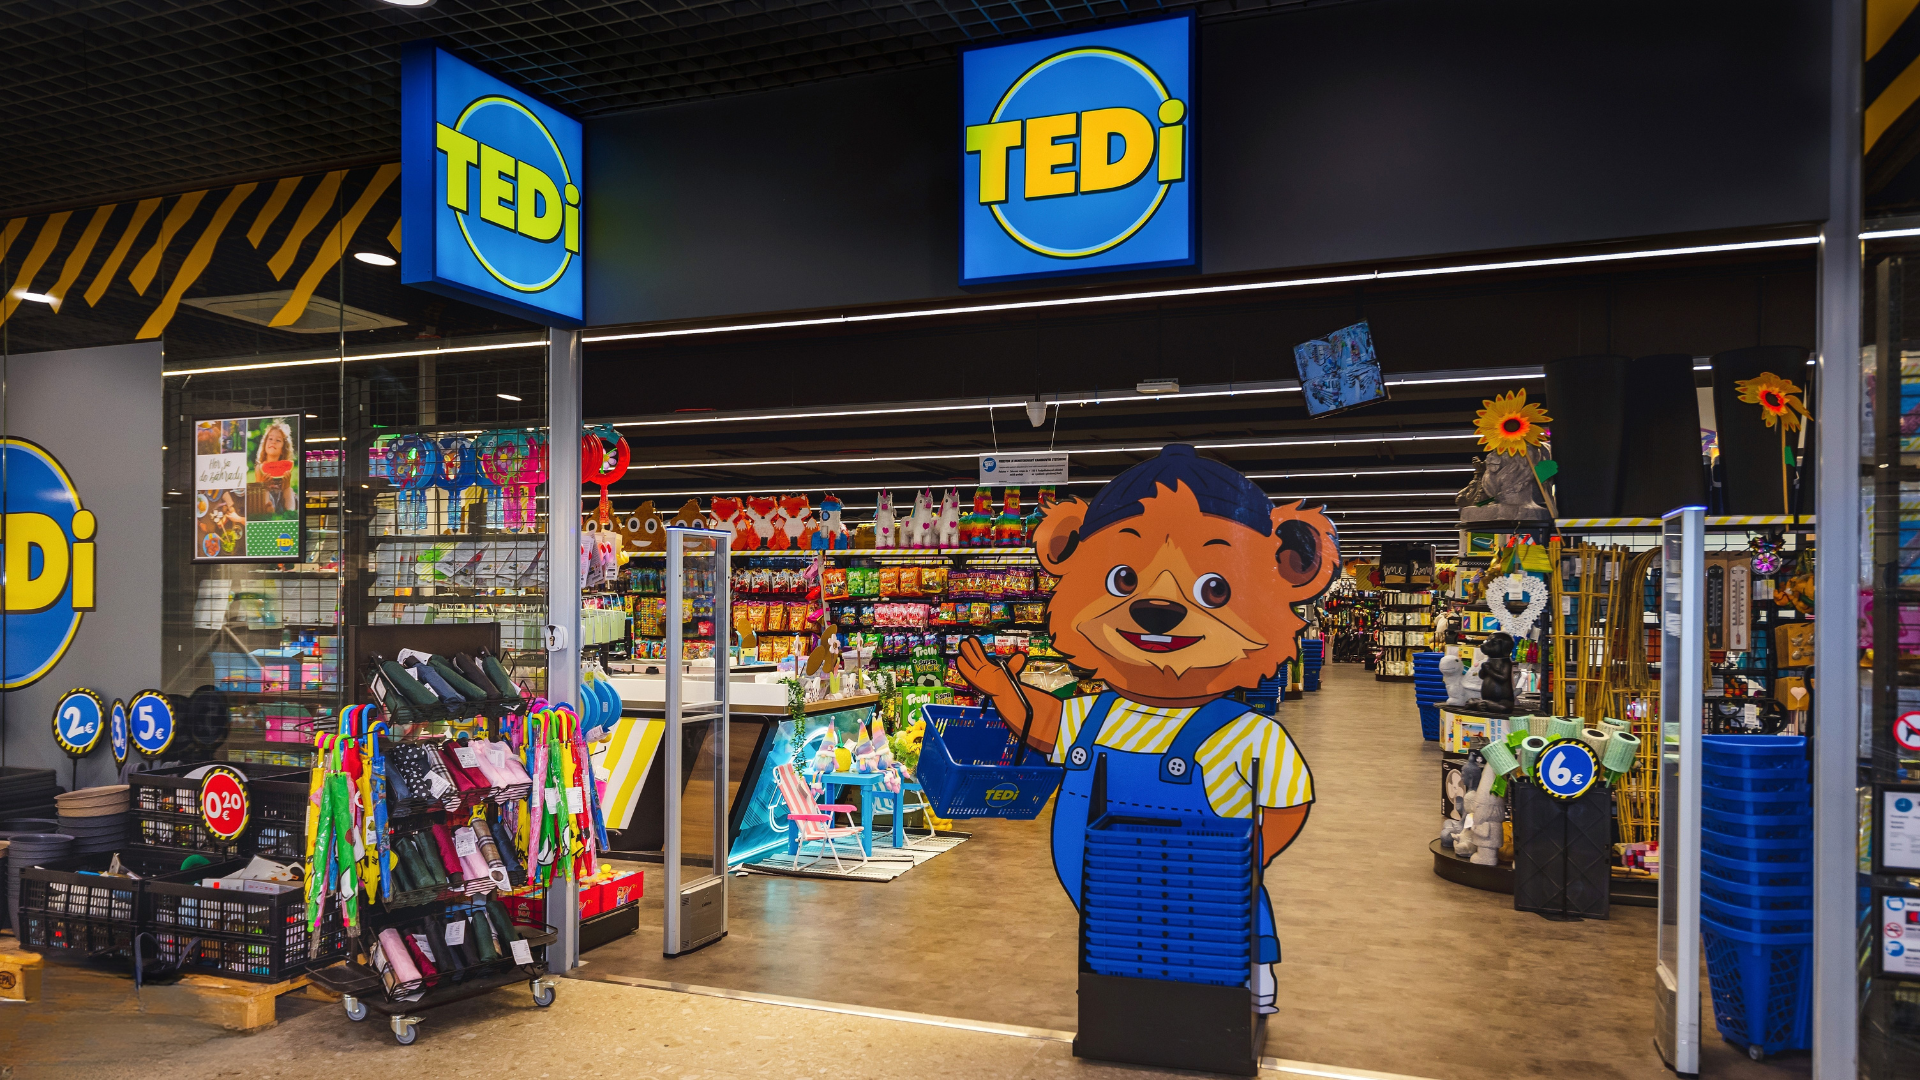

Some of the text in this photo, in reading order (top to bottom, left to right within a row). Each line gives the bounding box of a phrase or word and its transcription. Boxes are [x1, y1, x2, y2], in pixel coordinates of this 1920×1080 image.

[966, 98, 1187, 206] TEDi
[436, 121, 581, 256] TEDi
[276, 538, 294, 547] TEDi
[0, 509, 97, 612] Di
[913, 646, 937, 657] Trolli
[915, 664, 941, 673] KICK
[906, 693, 931, 705] Trolli
[985, 789, 1020, 801] TEDi
